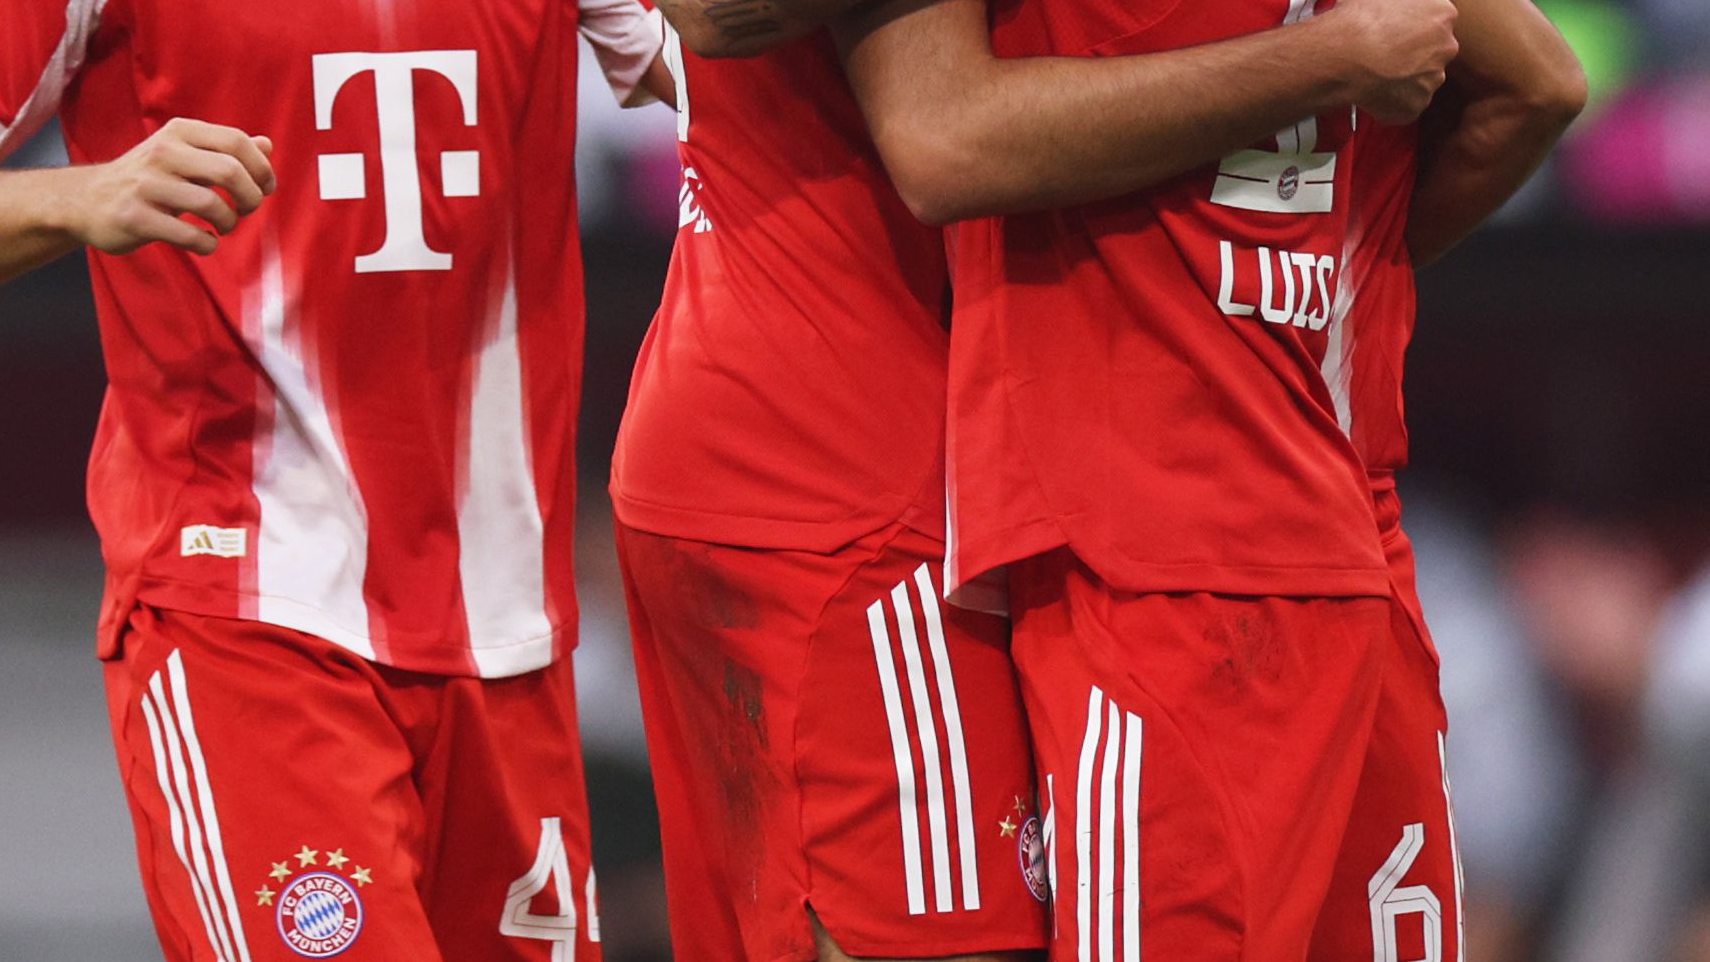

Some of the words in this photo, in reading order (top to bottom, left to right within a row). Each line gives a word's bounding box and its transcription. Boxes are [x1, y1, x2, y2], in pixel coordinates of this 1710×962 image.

[312, 49, 480, 273] T
[1217, 240, 1334, 331] LUIS
[282, 896, 297, 916] FC
[294, 878, 352, 905] BAYERN
[1368, 822, 1442, 962] 6
